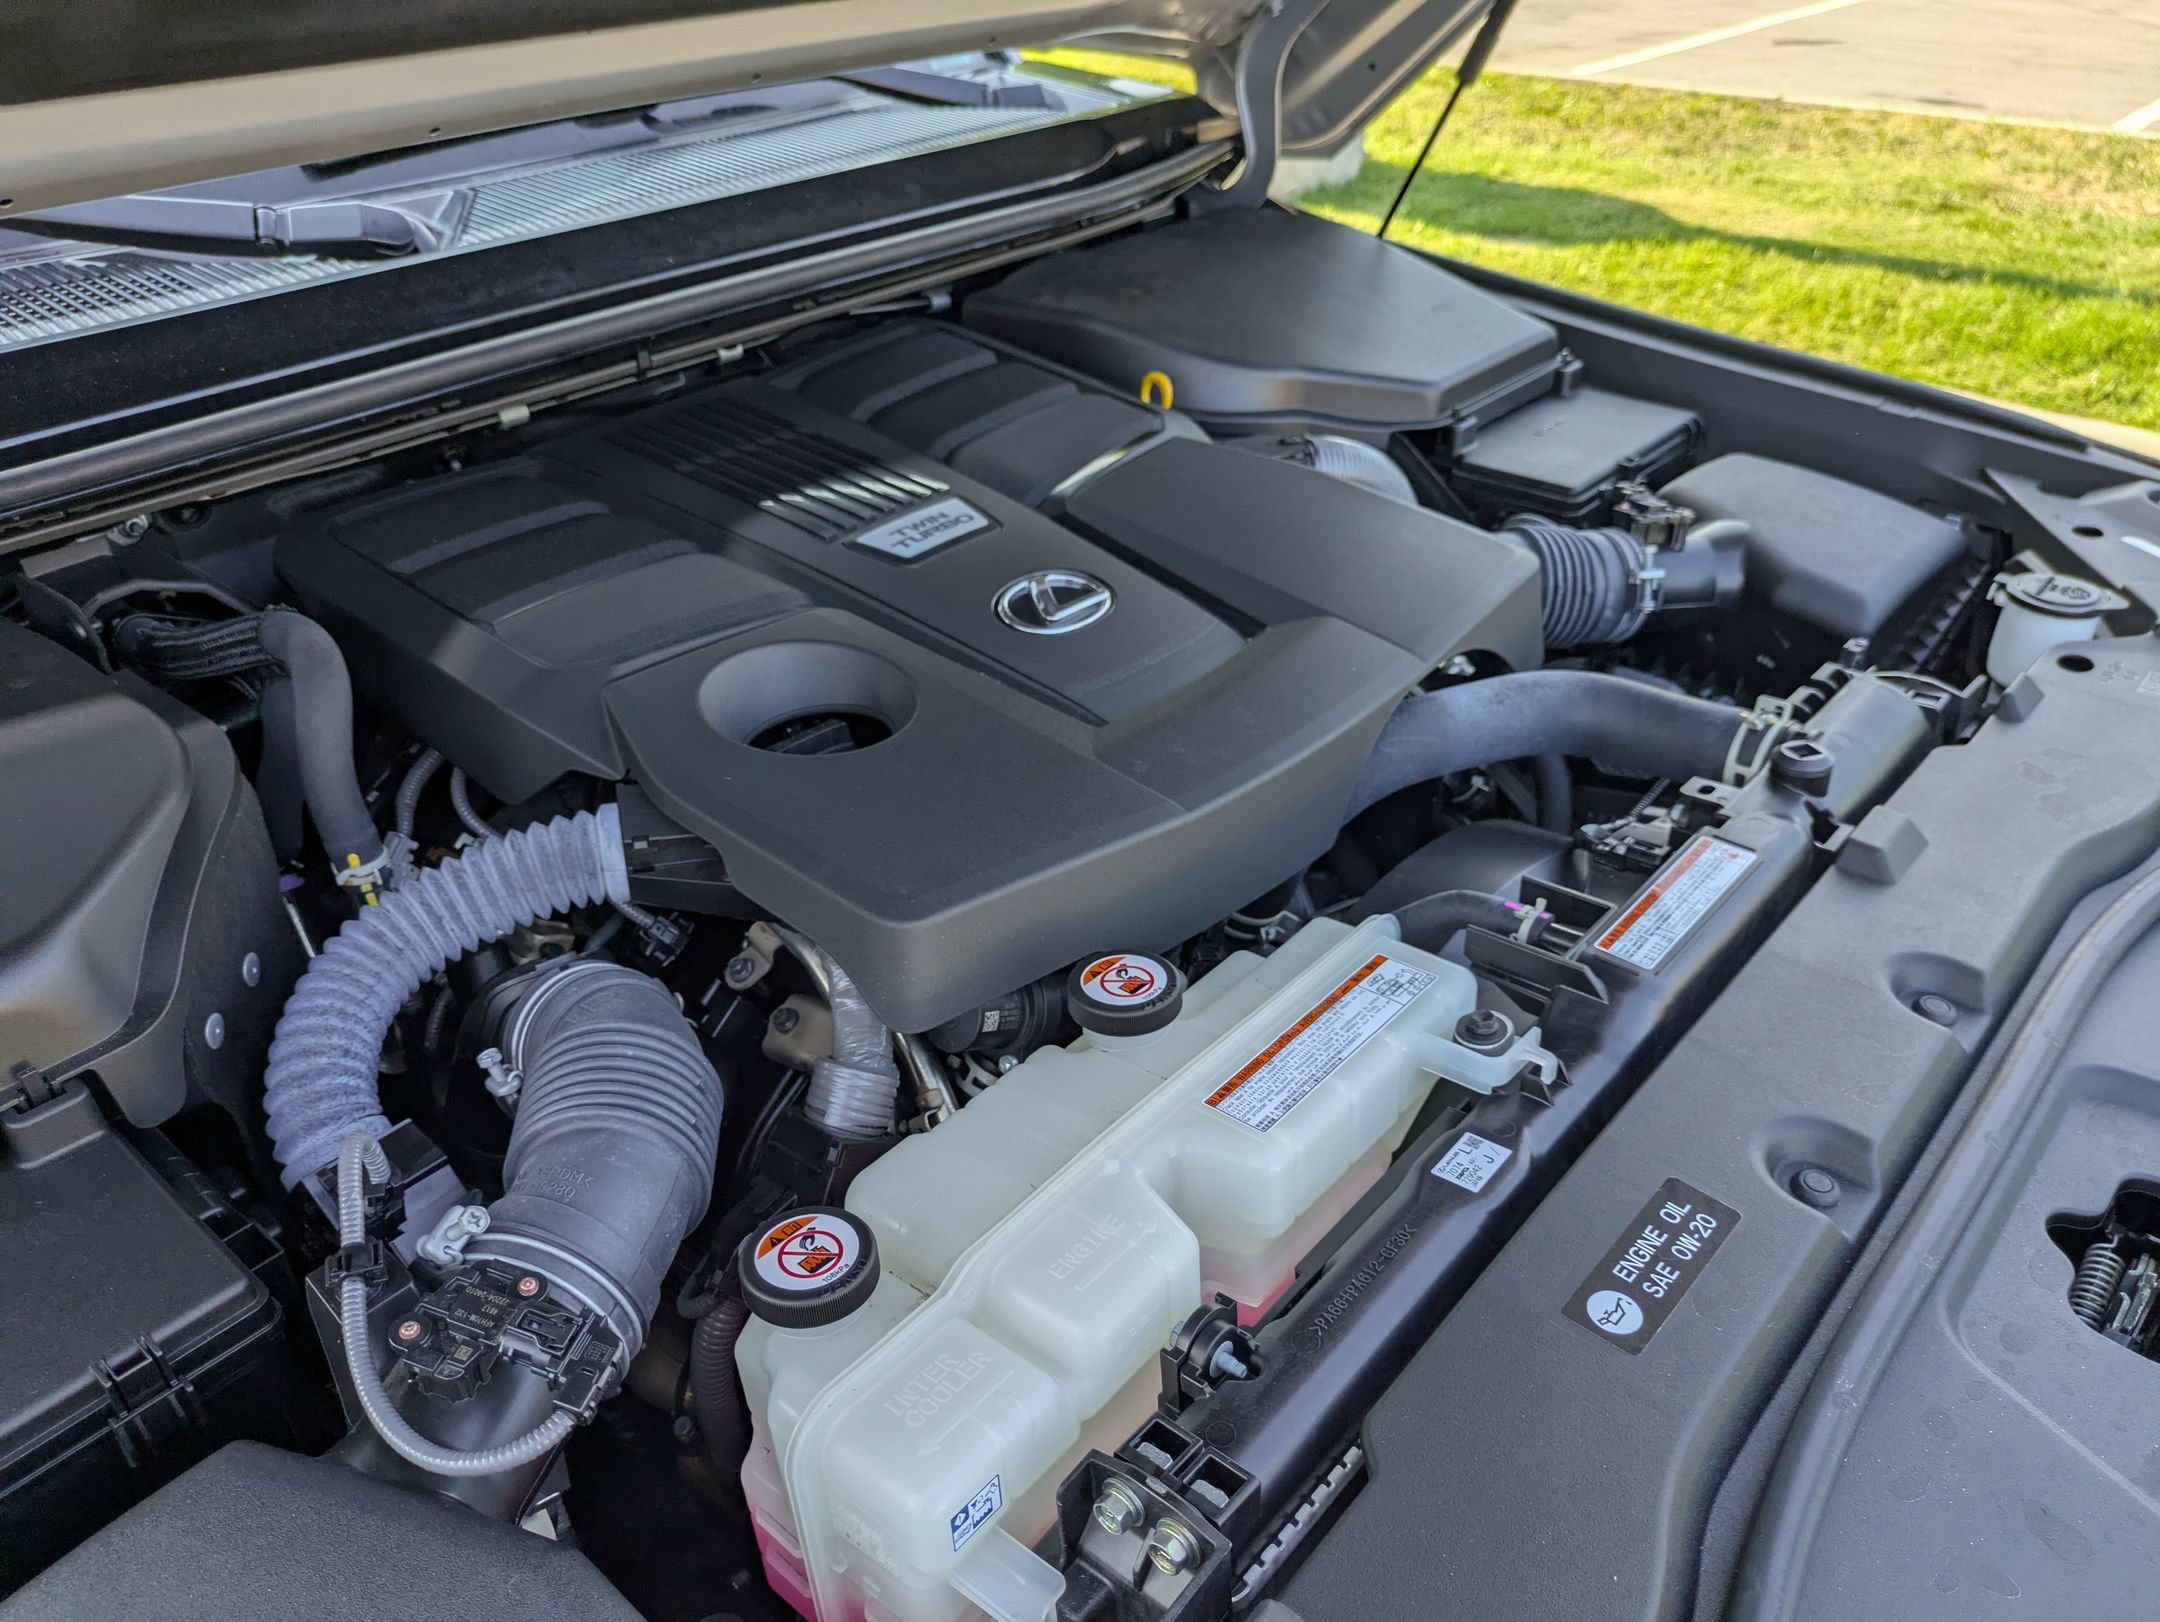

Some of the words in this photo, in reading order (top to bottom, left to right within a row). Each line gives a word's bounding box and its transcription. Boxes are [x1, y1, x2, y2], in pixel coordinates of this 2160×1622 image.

[888, 512, 950, 536] TWIN
[890, 513, 975, 548] TURBO
[821, 1263, 850, 1283] 108kPa
[1047, 1212, 1126, 1280] ENGINE
[1611, 1224, 1668, 1283] ENGINE
[1659, 1201, 1692, 1224] OIL
[1642, 1261, 1680, 1298] SAE
[1671, 1213, 1717, 1261] 0W-20
[883, 1353, 961, 1417] INTER
[904, 1348, 995, 1429] COOLER
